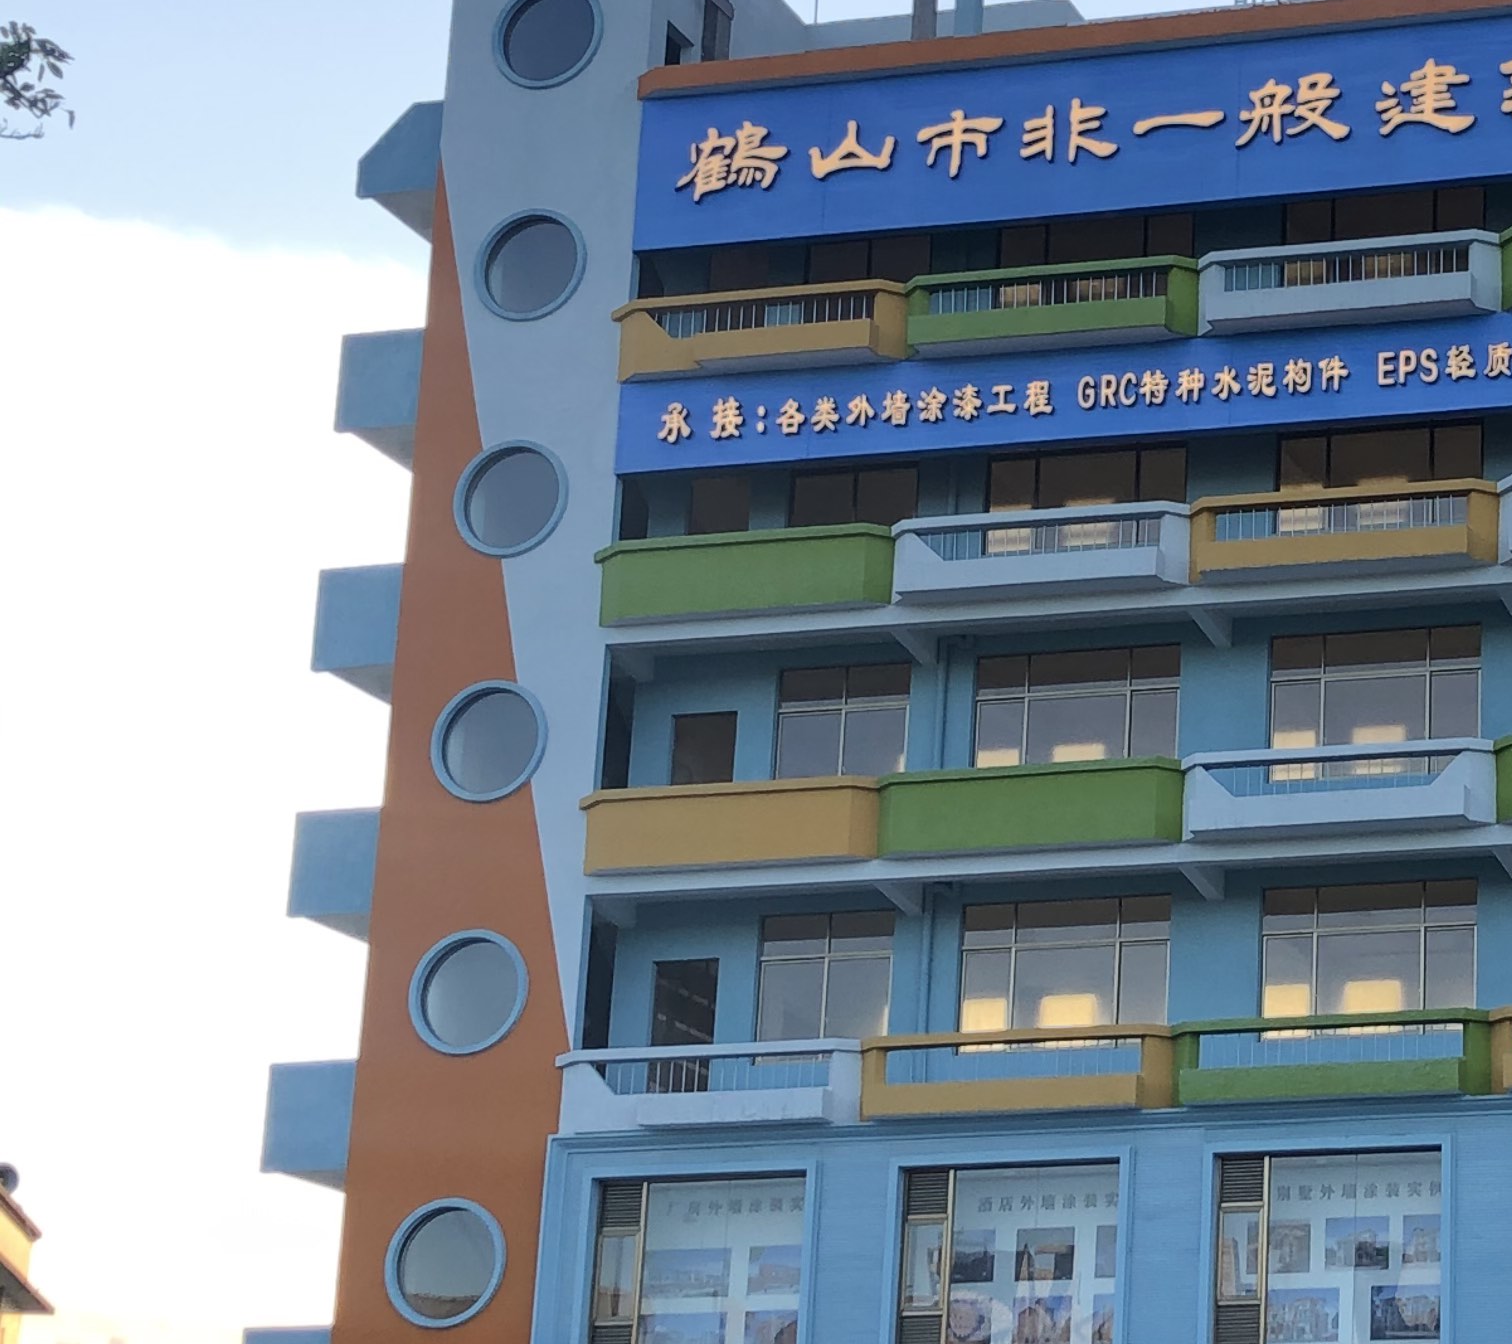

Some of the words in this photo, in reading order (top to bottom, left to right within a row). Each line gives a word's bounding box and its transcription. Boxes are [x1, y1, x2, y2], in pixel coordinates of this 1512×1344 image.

[1078, 357, 1350, 410] GRC特种水泥构件
